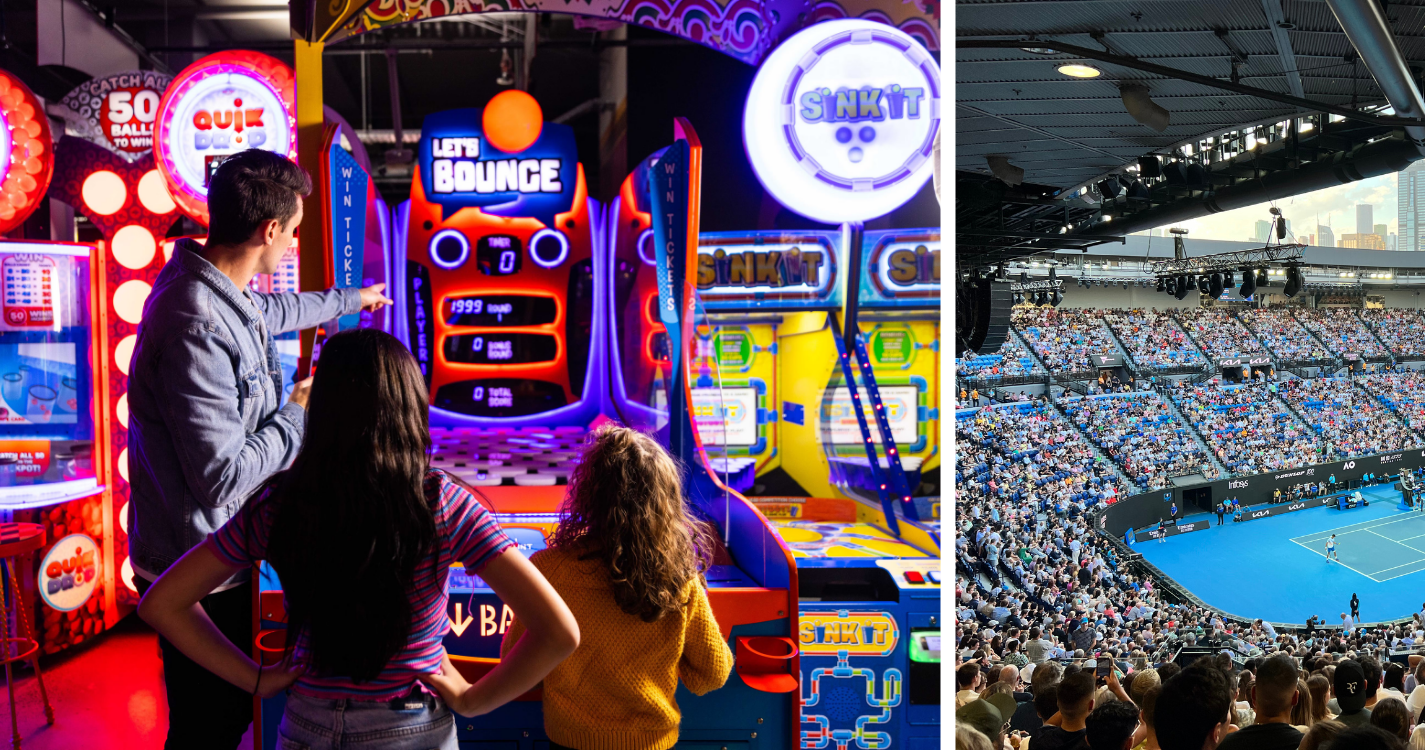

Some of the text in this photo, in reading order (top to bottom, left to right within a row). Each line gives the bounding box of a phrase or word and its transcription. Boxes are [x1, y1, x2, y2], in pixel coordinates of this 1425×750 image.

[89, 74, 140, 96] CATCH
[108, 90, 160, 123] 50
[115, 138, 129, 148] TO
[432, 137, 479, 158] LET'S
[433, 159, 562, 193] BOUNCE
[342, 167, 353, 286] WIN TICKE
[665, 163, 675, 311] WIN TICKETS
[413, 277, 428, 361] PLAYER
[1228, 479, 1249, 490] Infosys
[799, 619, 859, 645] SINK
